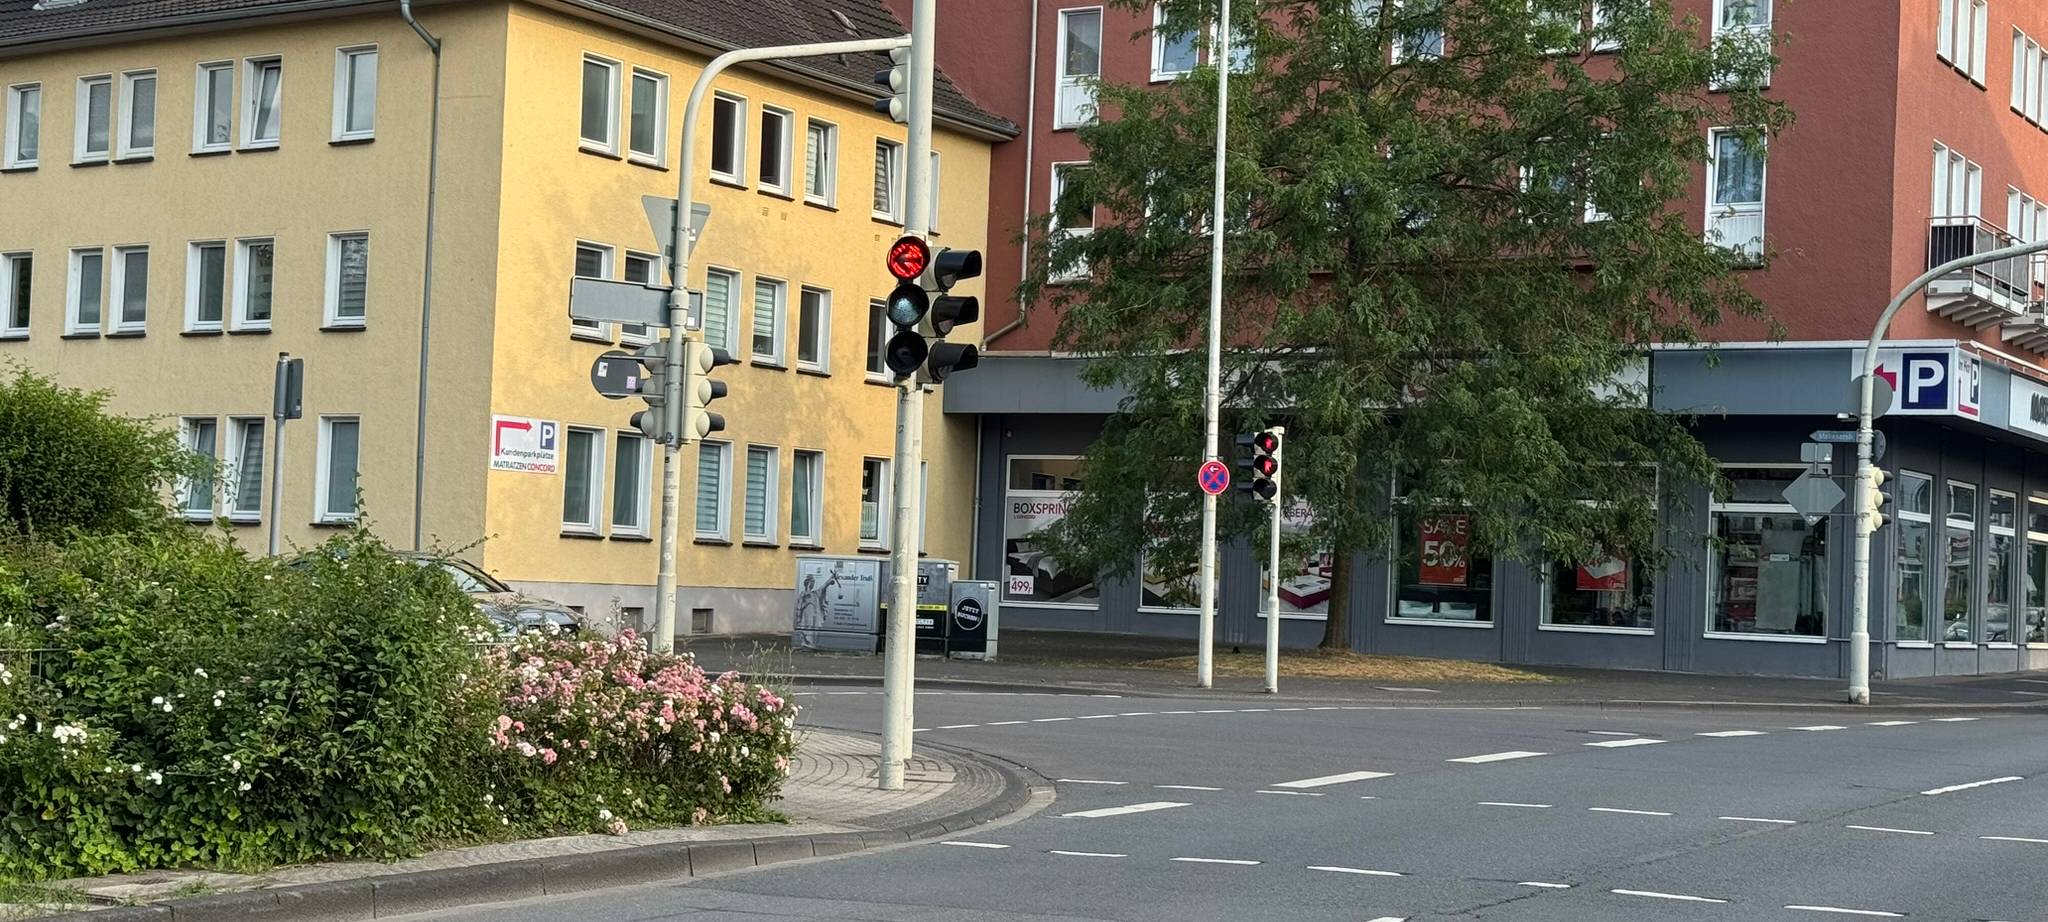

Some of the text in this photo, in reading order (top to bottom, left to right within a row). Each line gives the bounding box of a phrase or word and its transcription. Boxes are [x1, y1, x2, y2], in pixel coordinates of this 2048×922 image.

[1908, 359, 1945, 403] P
[1971, 363, 1979, 399] P
[542, 424, 554, 448] P
[501, 447, 555, 460] Kundenparkplätze
[493, 460, 556, 472] MATRATZEN CONCORD
